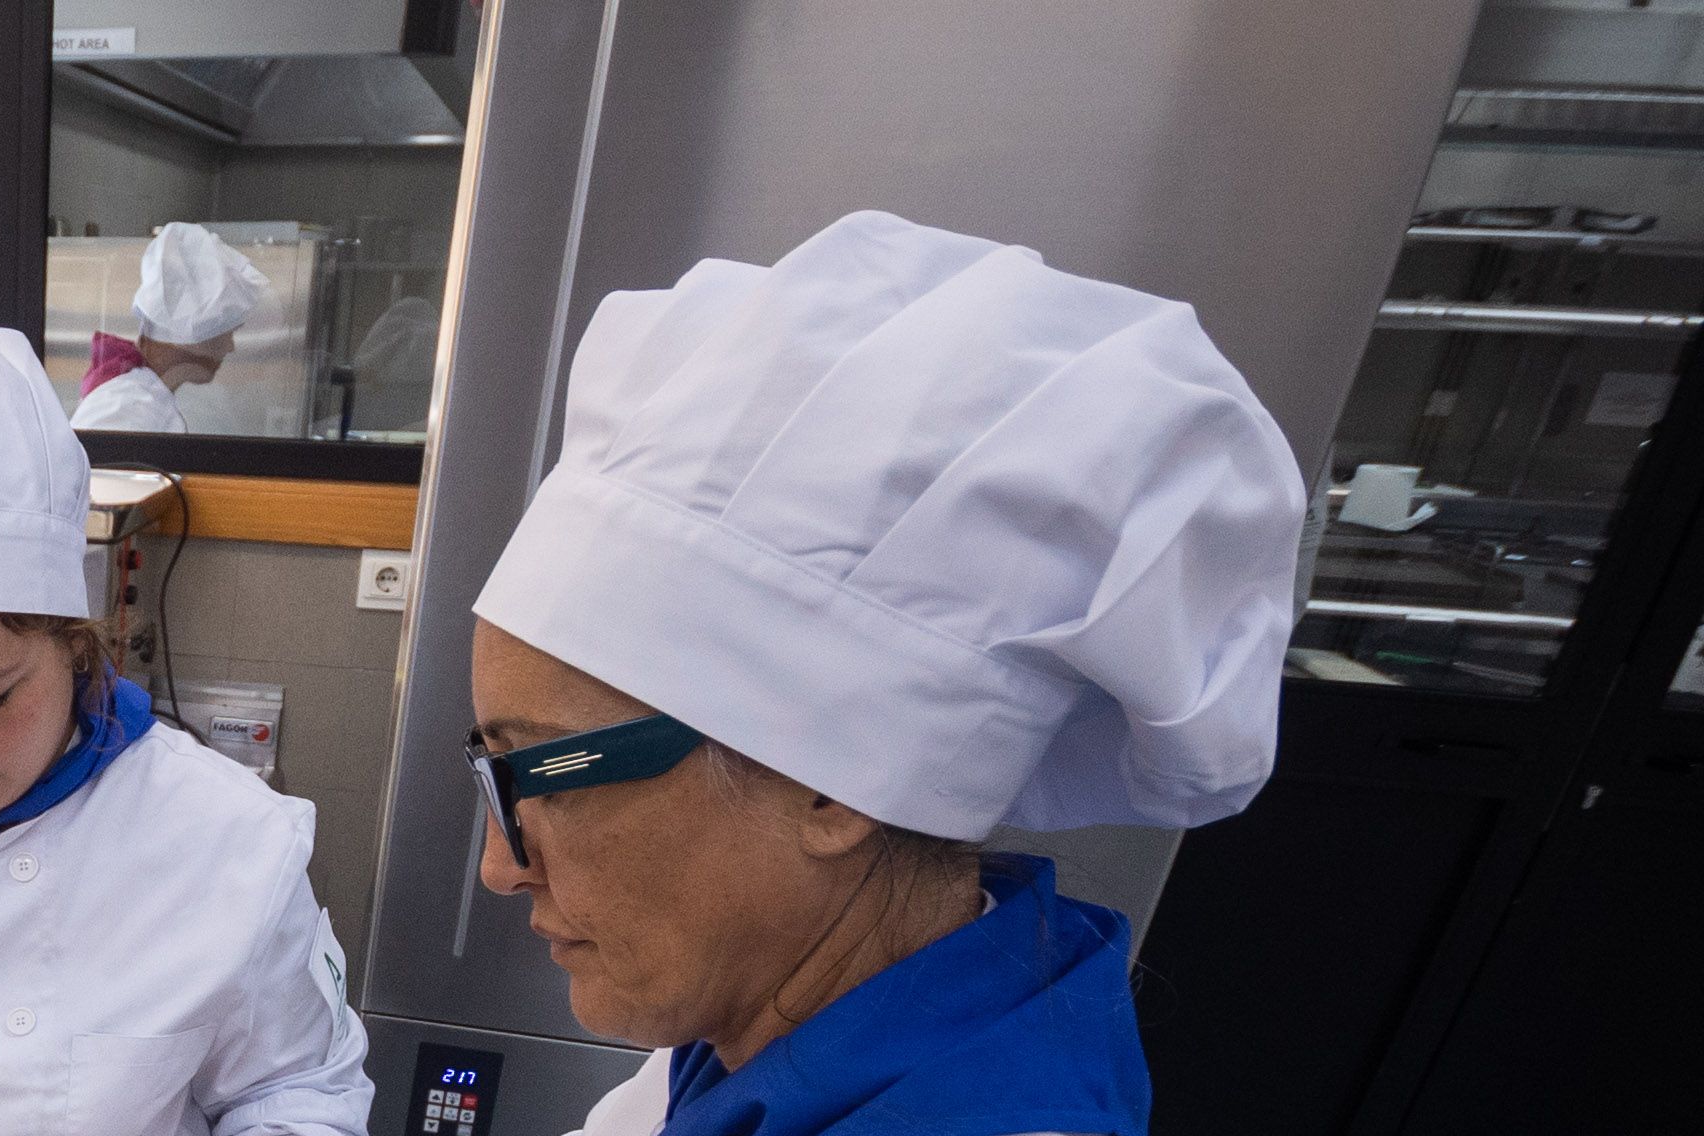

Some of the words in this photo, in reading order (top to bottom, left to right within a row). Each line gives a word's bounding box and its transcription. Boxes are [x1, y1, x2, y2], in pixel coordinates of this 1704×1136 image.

[78, 39, 110, 49] AREA
[213, 722, 248, 734] FAGOR
[442, 1068, 476, 1085] 217
